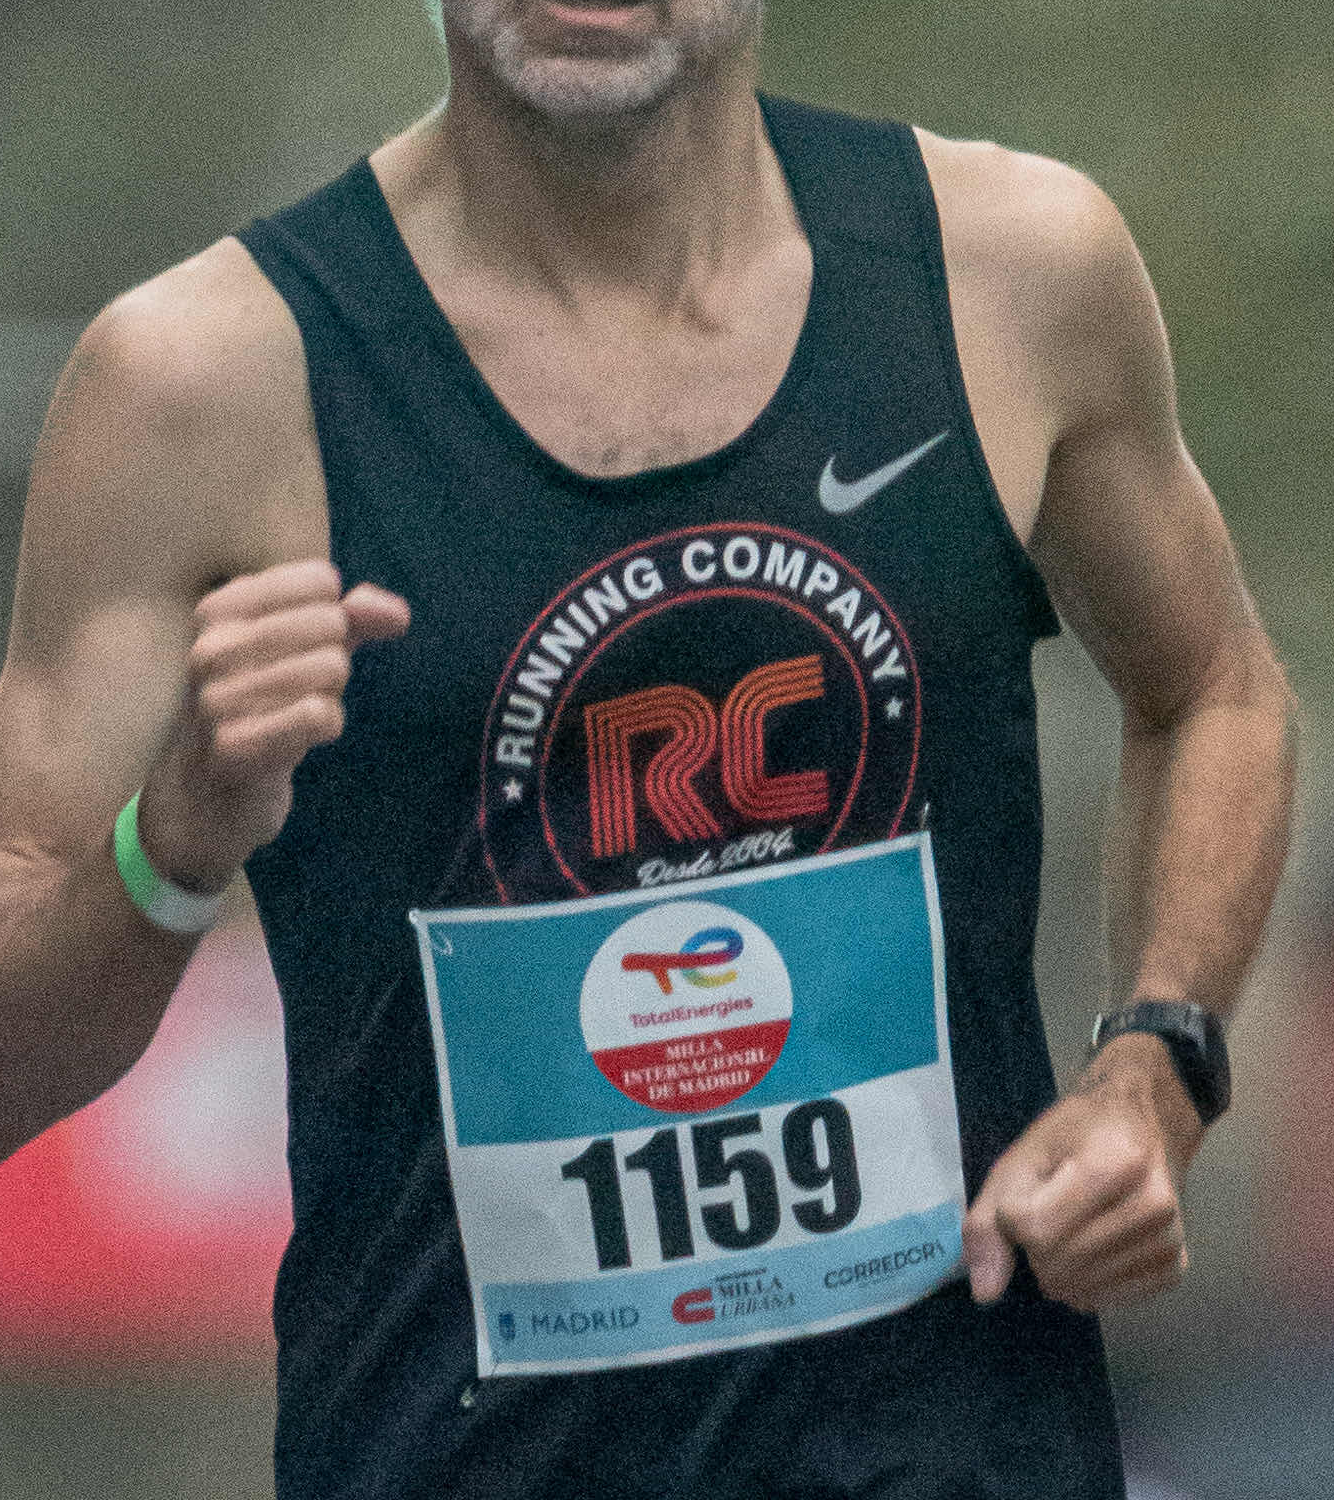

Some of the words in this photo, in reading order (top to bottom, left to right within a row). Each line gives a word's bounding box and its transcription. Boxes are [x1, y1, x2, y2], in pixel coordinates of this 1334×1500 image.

[496, 556, 664, 767] RUNNING
[682, 536, 907, 683] COMPANY
[584, 654, 830, 858] RC
[629, 996, 754, 1028] TotalEnergies
[665, 1038, 724, 1060] MILLA
[678, 1069, 751, 1095] MADRID
[560, 1098, 863, 1272] 1159
[530, 1306, 640, 1336] MADRID
